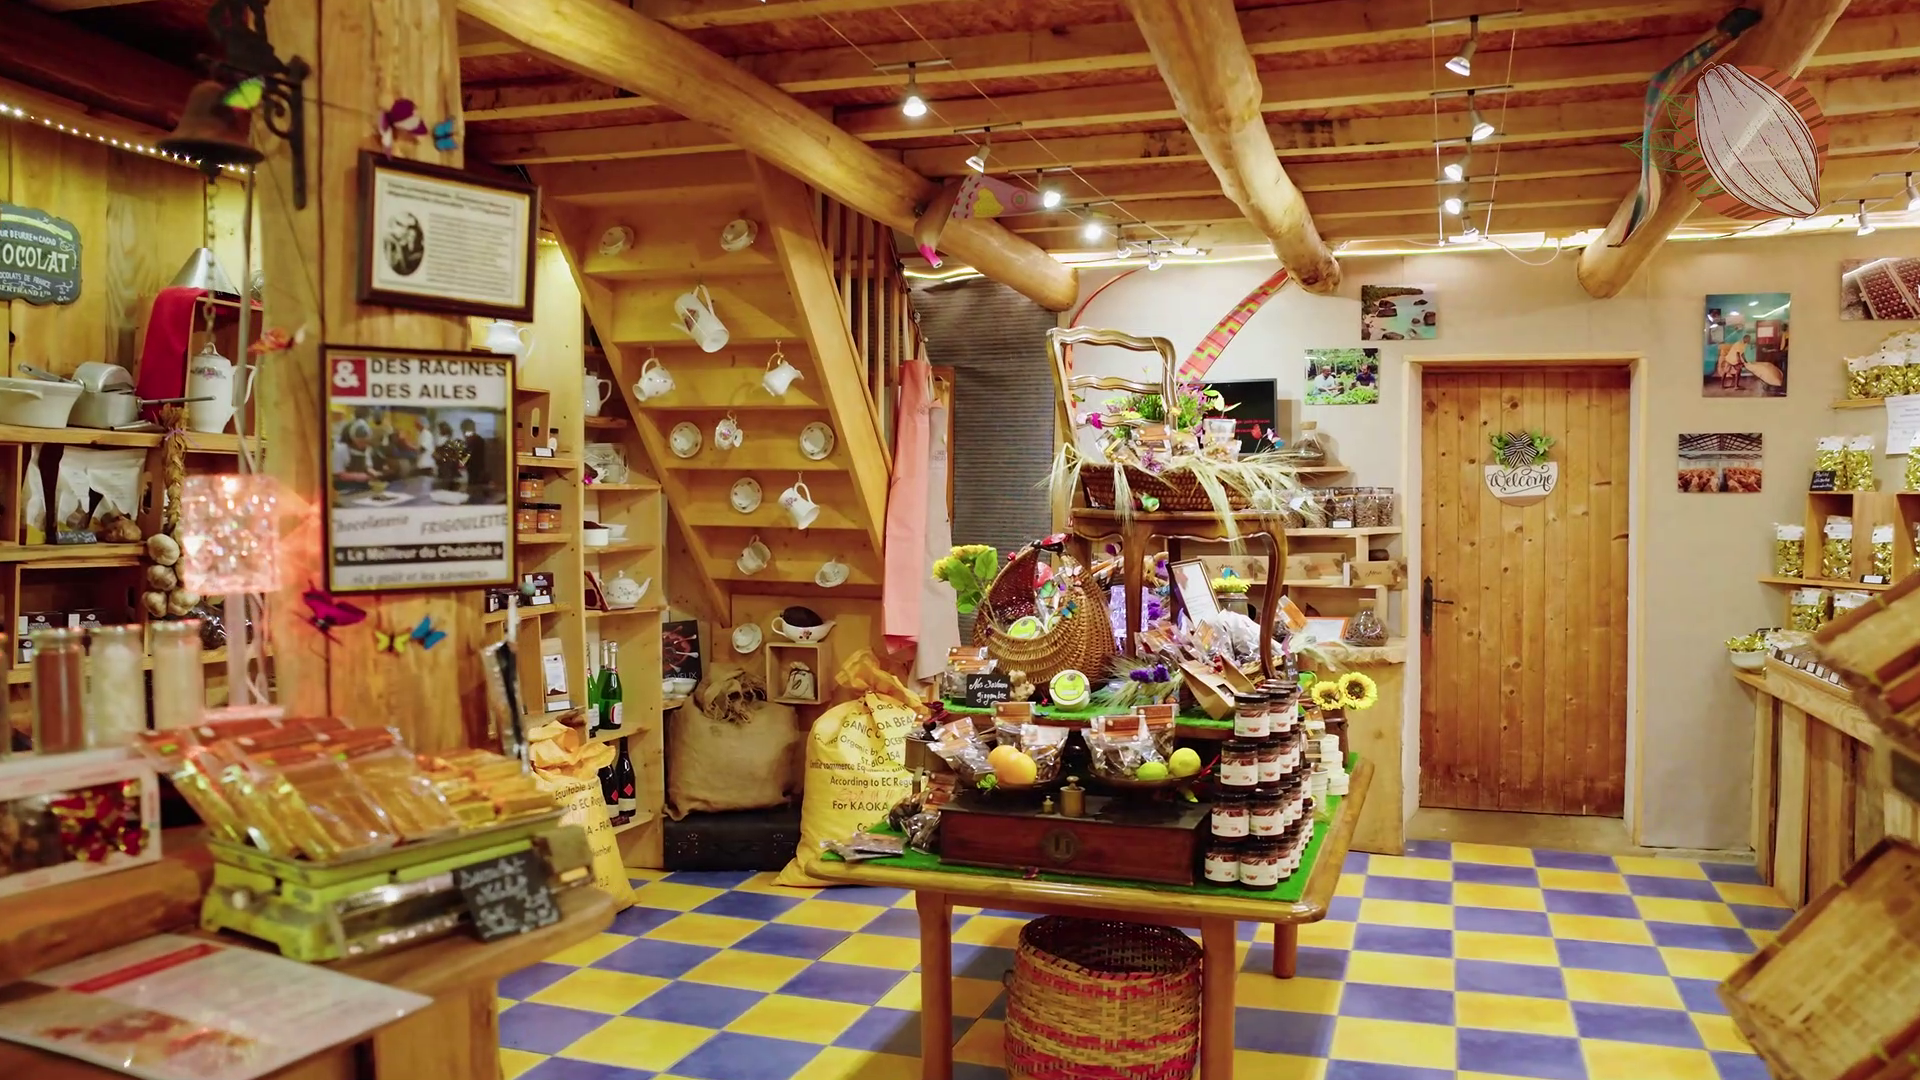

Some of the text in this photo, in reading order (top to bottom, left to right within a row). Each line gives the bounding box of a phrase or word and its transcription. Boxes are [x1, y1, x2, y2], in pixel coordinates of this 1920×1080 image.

[9, 229, 33, 242] BEURRE
[38, 235, 57, 246] CACAO
[2, 243, 69, 273] OCOLAT
[371, 359, 507, 377] DES RACINES
[371, 383, 477, 400] DES AILES
[1487, 468, 1553, 492] Welcome
[347, 549, 365, 562] Le
[840, 735, 869, 755] Organic
[870, 748, 879, 757] by
[871, 751, 901, 768] BIO-154
[829, 776, 869, 788] According
[871, 779, 880, 787] to
[881, 778, 892, 787] EC
[579, 798, 590, 809] EC
[832, 800, 888, 811] For KAOKA
